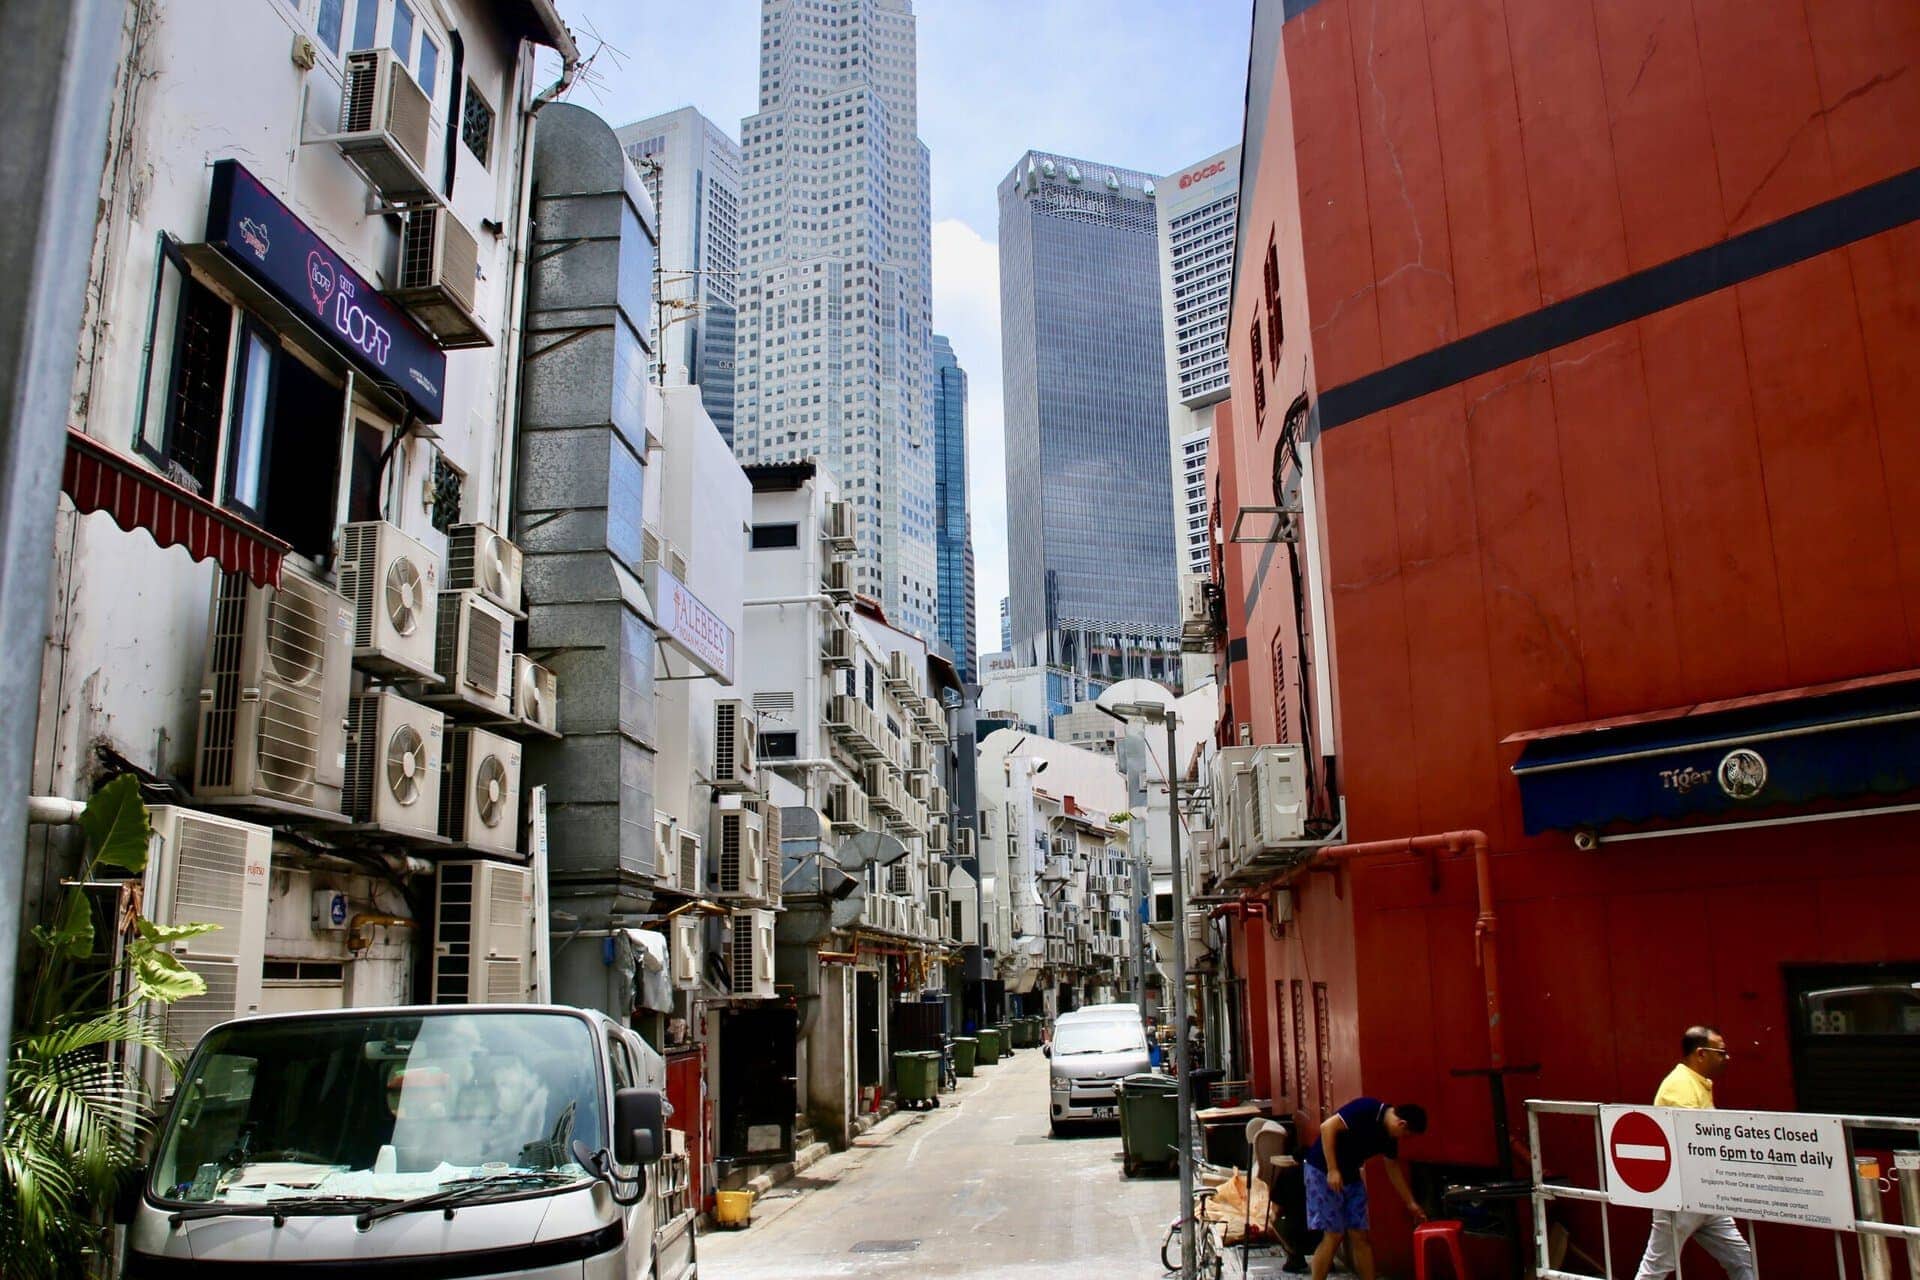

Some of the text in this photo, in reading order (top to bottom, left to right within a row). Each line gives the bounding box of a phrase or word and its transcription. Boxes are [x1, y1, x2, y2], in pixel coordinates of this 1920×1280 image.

[1193, 160, 1225, 182] OCBC
[1045, 188, 1107, 212] CapitaLand
[339, 274, 355, 299] THE
[336, 292, 391, 366] LOFT
[1659, 767, 1712, 794] Tiger
[1695, 1122, 1818, 1143] Swing Gates Closed
[1687, 1142, 1833, 1169] from 6pm to 4am daily
